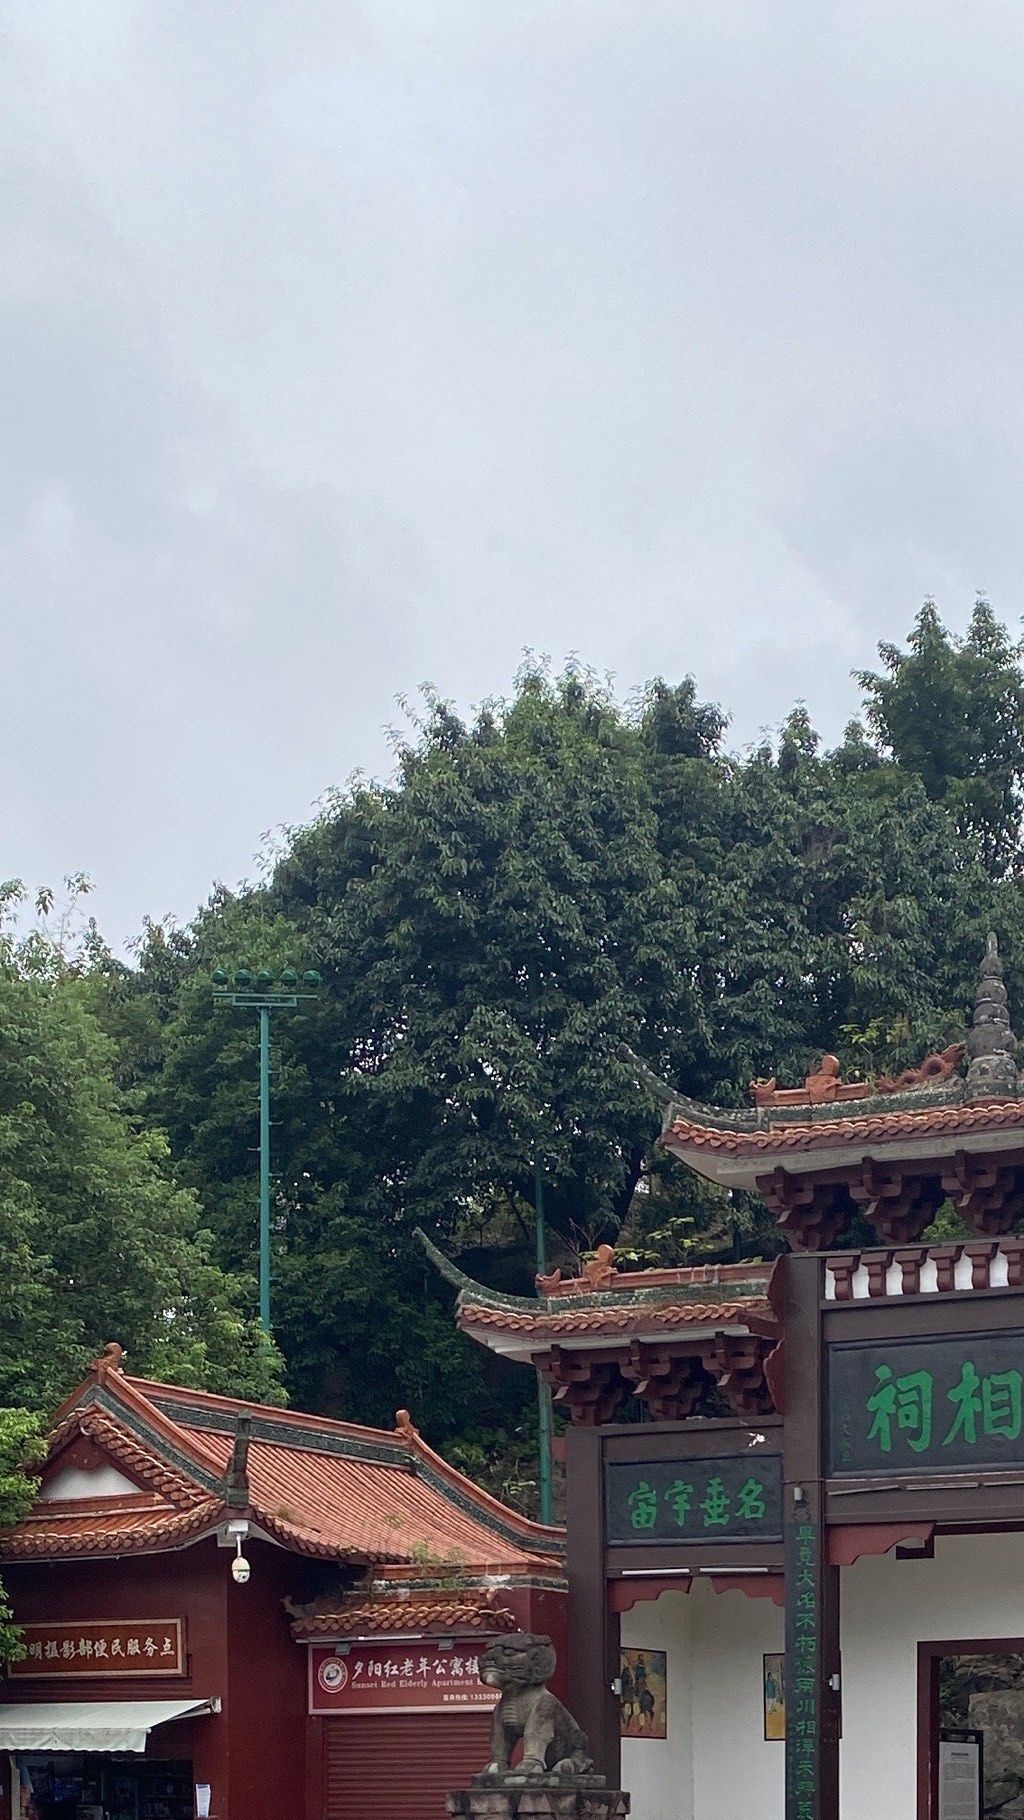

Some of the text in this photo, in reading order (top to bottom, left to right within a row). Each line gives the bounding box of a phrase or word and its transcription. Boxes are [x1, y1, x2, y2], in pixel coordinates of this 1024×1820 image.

[28, 1637, 175, 1660] 明摄影部便民服务点
[352, 1681, 378, 1689] Sunset
[381, 1680, 396, 1688] Red
[400, 1679, 428, 1688] Elderly
[432, 1678, 474, 1688] Apartment
